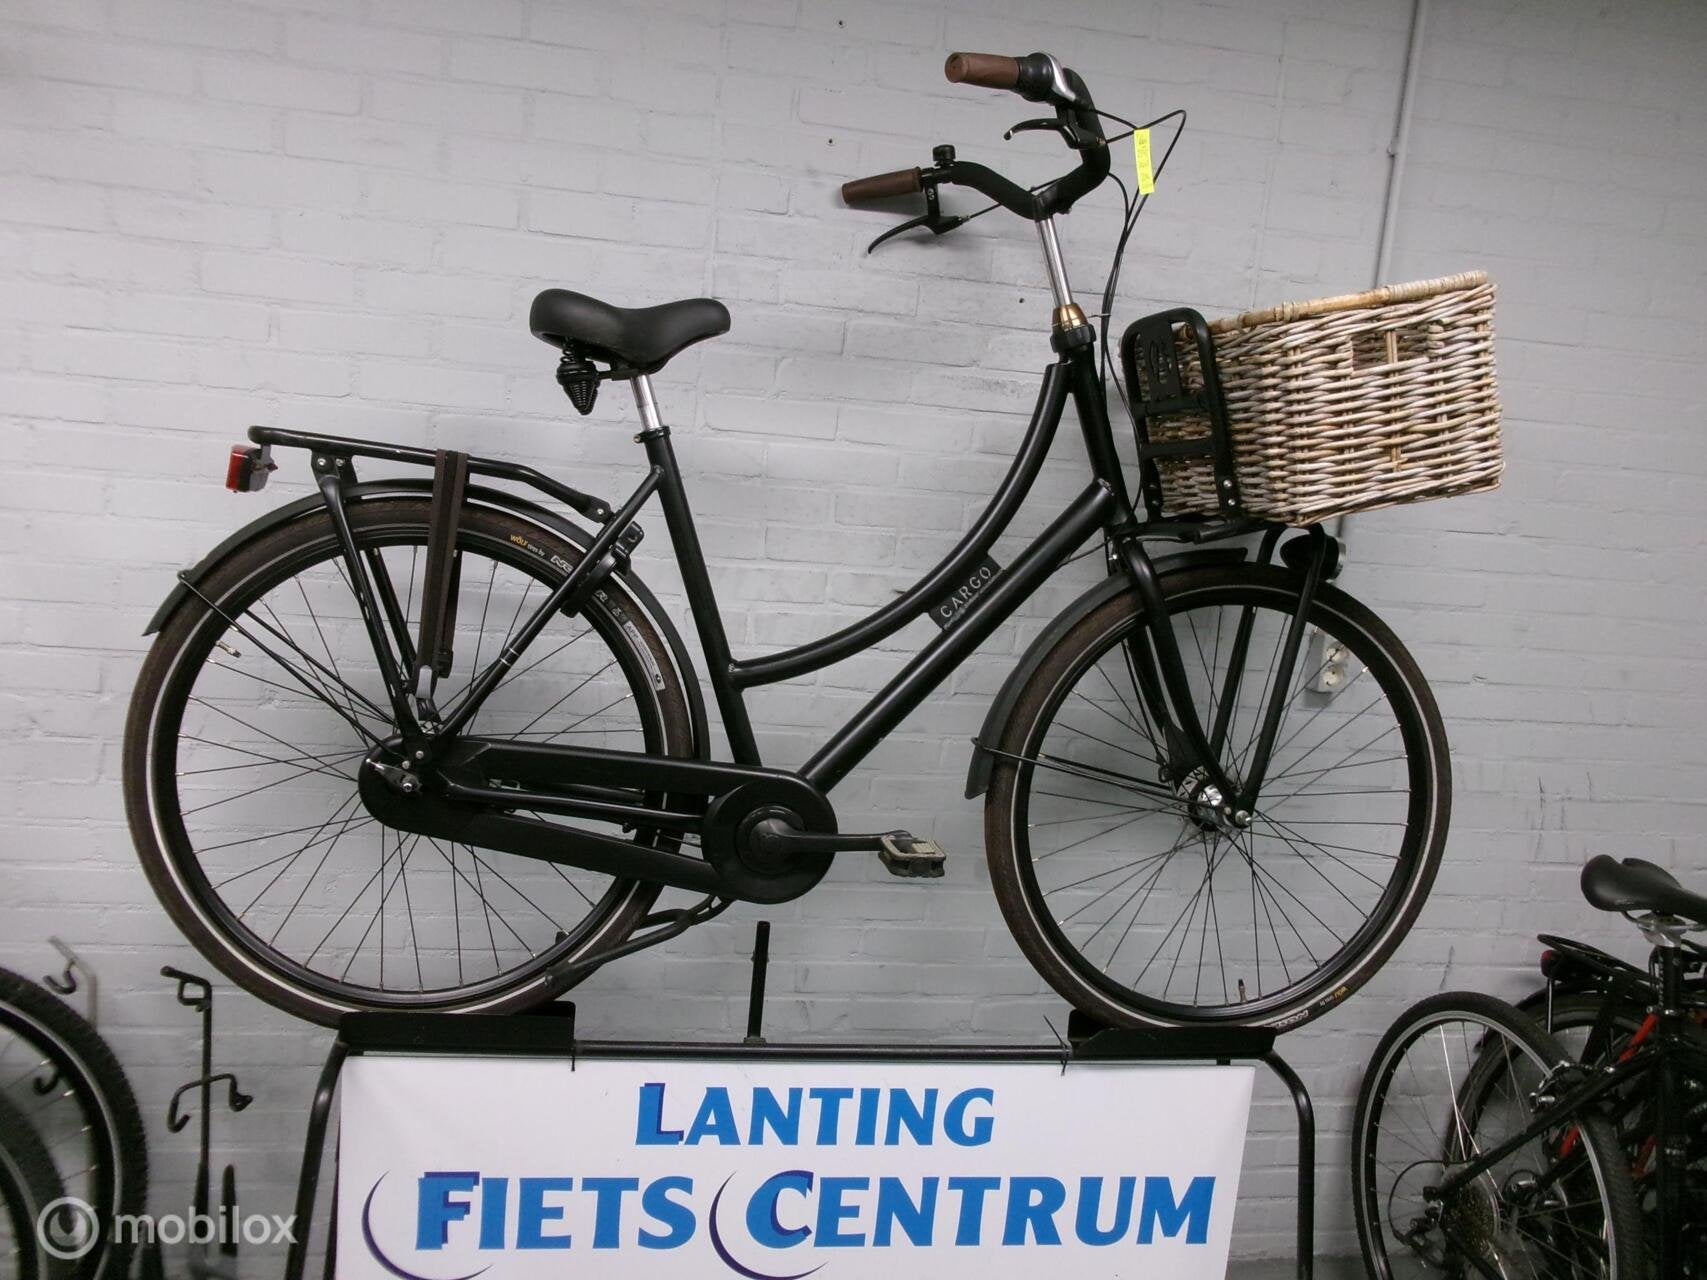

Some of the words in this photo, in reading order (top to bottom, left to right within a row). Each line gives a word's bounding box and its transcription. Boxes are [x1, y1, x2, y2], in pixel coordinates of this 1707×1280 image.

[939, 566, 992, 618] CARGO
[635, 1082, 994, 1147] LANTING
[415, 1171, 697, 1250] FIETS
[745, 1171, 1217, 1249] CENTRUM
